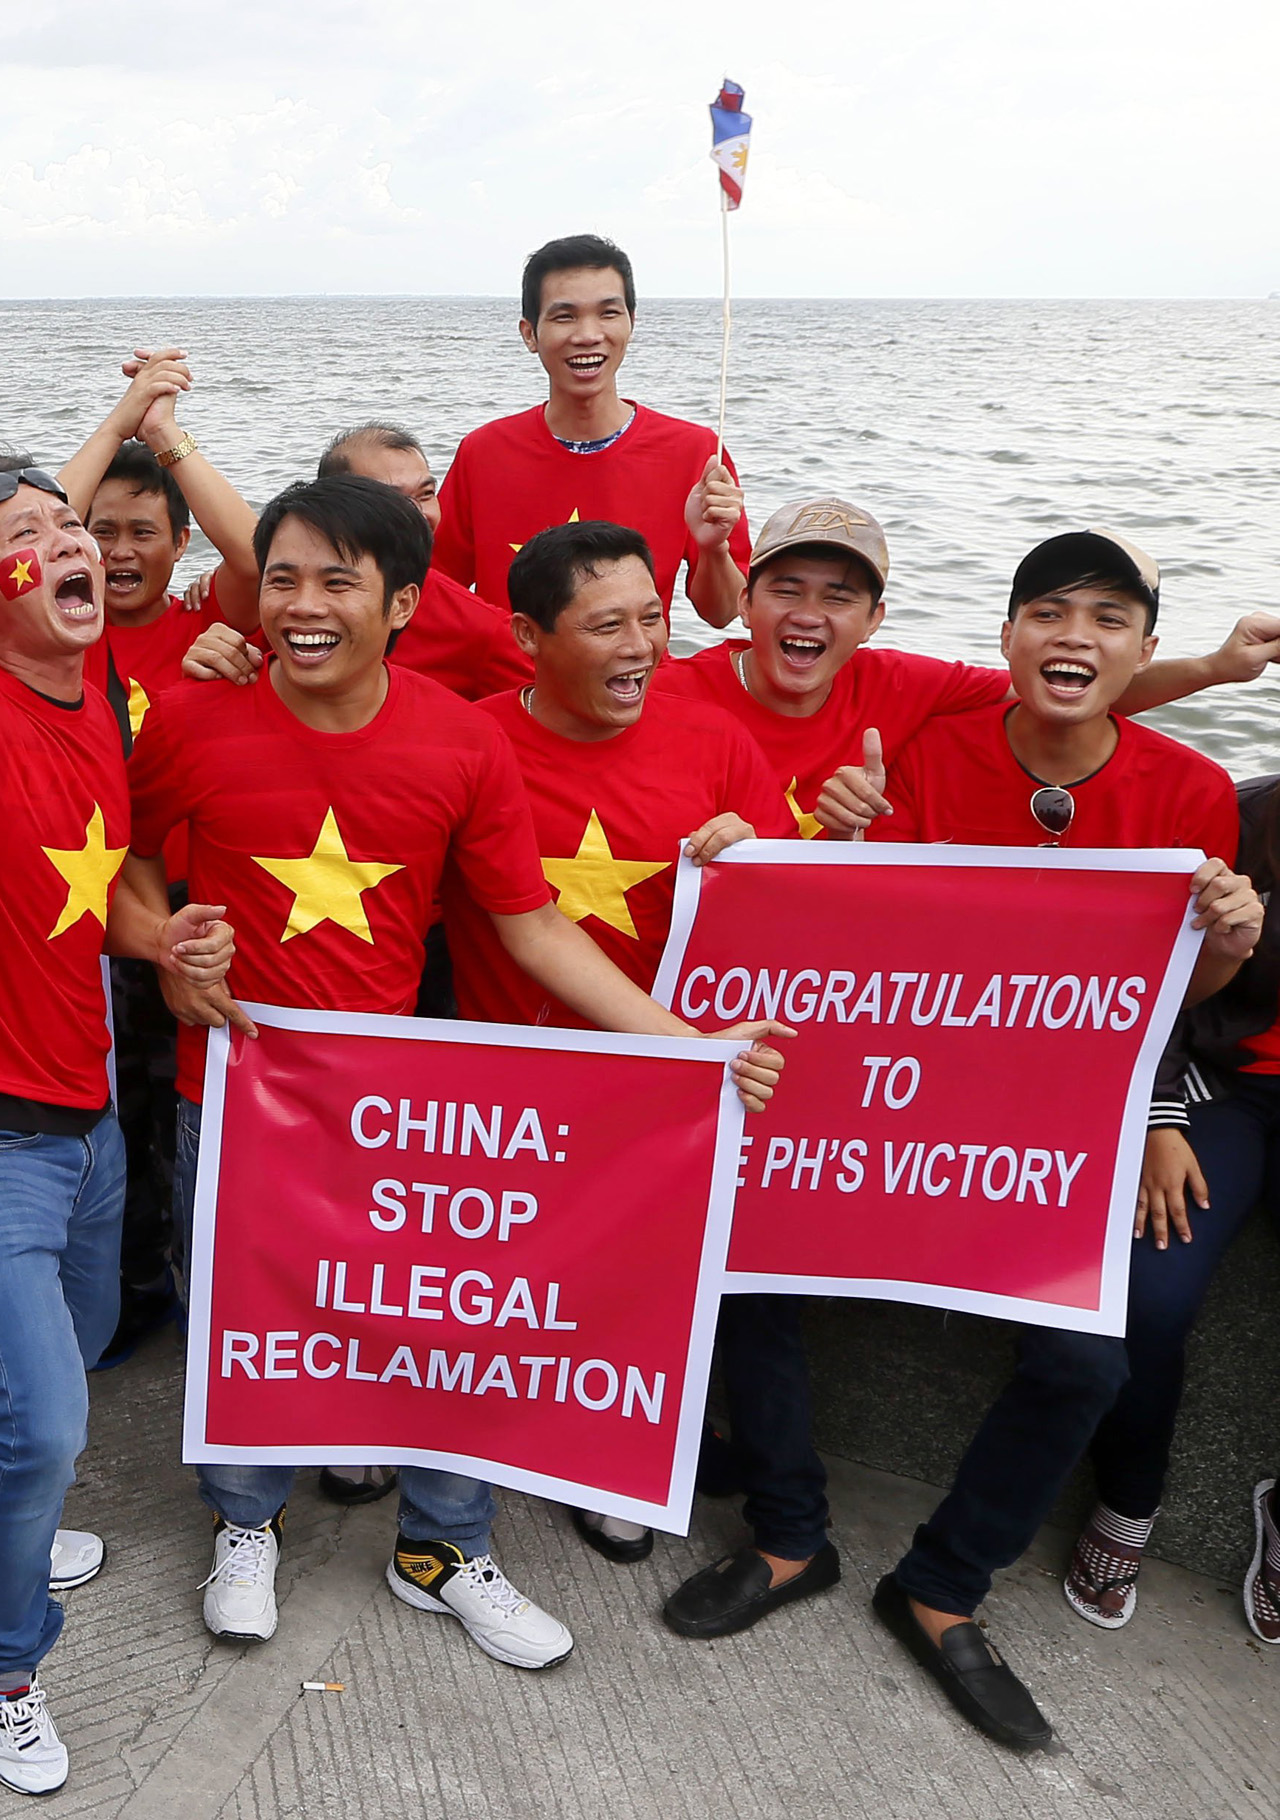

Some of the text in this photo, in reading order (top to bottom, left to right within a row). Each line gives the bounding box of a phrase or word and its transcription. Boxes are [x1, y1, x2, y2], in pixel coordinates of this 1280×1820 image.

[680, 965, 1147, 1032] CONGRATULATIONS
[861, 1056, 921, 1110] TO
[350, 1095, 569, 1163] CHINA:
[884, 1141, 1088, 1208] VICTORY
[368, 1178, 538, 1242] STOP
[314, 1259, 578, 1331] ILLEGAL
[221, 1329, 666, 1425] RECLAMATION
